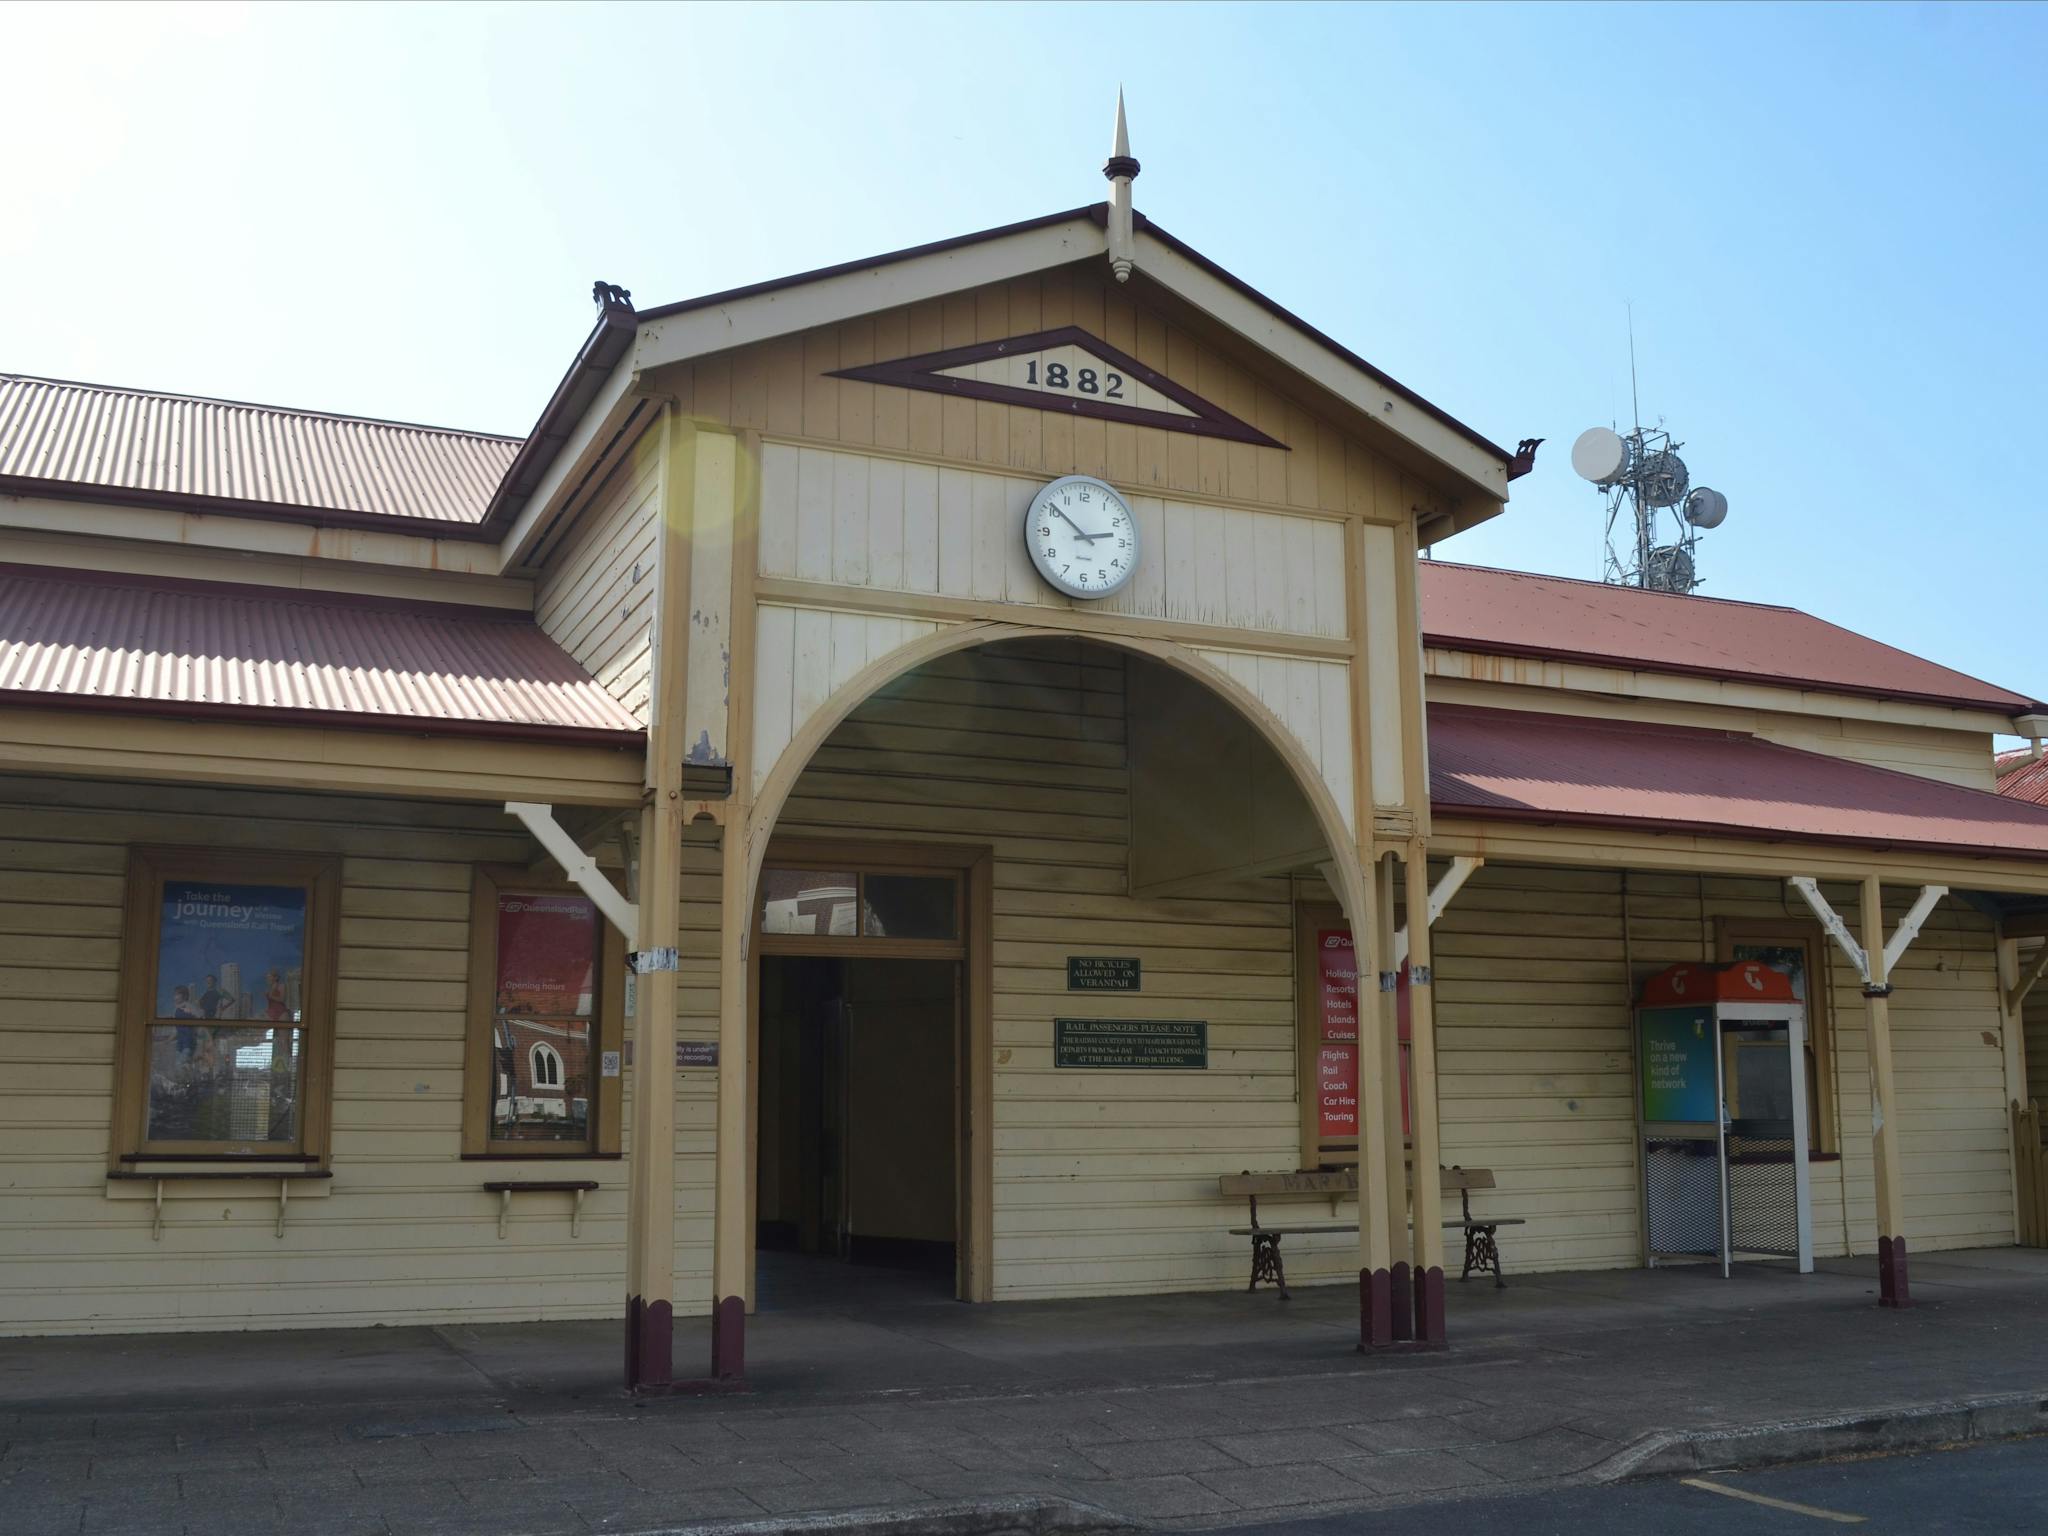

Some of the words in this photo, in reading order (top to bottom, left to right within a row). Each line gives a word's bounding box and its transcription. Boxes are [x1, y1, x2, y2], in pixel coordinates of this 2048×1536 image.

[1027, 360, 1123, 398] 1882
[1064, 496, 1071, 506] 11
[1080, 493, 1090, 503] 12
[1049, 508, 1060, 518] 10
[1112, 518, 1120, 527] 2
[1042, 527, 1050, 536] 9
[1118, 539, 1126, 548] 3
[1048, 548, 1056, 558] 8
[1111, 559, 1119, 568] 4
[1063, 564, 1070, 574] 7
[1080, 573, 1088, 582] 6
[1099, 570, 1106, 579] 5
[184, 891, 209, 901] Take
[212, 892, 231, 902] the
[173, 899, 254, 922] journey
[200, 919, 250, 928] Queensland
[1079, 960, 1091, 968] NO
[1074, 969, 1116, 977] ALLOWED
[505, 980, 540, 992] Opening
[542, 981, 565, 990] hours
[1080, 979, 1129, 987] VERANDAH
[1326, 984, 1355, 993] Resorts
[1327, 1000, 1352, 1009] Hotels
[1328, 1015, 1356, 1024] Islands
[1066, 1023, 1086, 1031] RAIL
[1090, 1023, 1139, 1032] PASSENGERS
[1141, 1024, 1171, 1032] PLEASE
[1173, 1025, 1195, 1033] NOTE
[1328, 1031, 1356, 1039] Cruises
[1649, 1040, 1676, 1051] Thrive
[684, 1055, 712, 1063] recording
[1322, 1050, 1349, 1061] Flights
[1650, 1054, 1661, 1062] on
[1662, 1054, 1668, 1062] a
[1669, 1054, 1687, 1062] new
[1323, 1066, 1338, 1075] Rail
[1651, 1065, 1669, 1076] kind
[1670, 1065, 1680, 1075] of
[1323, 1081, 1348, 1090] Coach
[1652, 1078, 1687, 1089] network
[1324, 1097, 1337, 1105] Car
[1339, 1097, 1356, 1105] Hire
[1324, 1112, 1354, 1122] Touring
